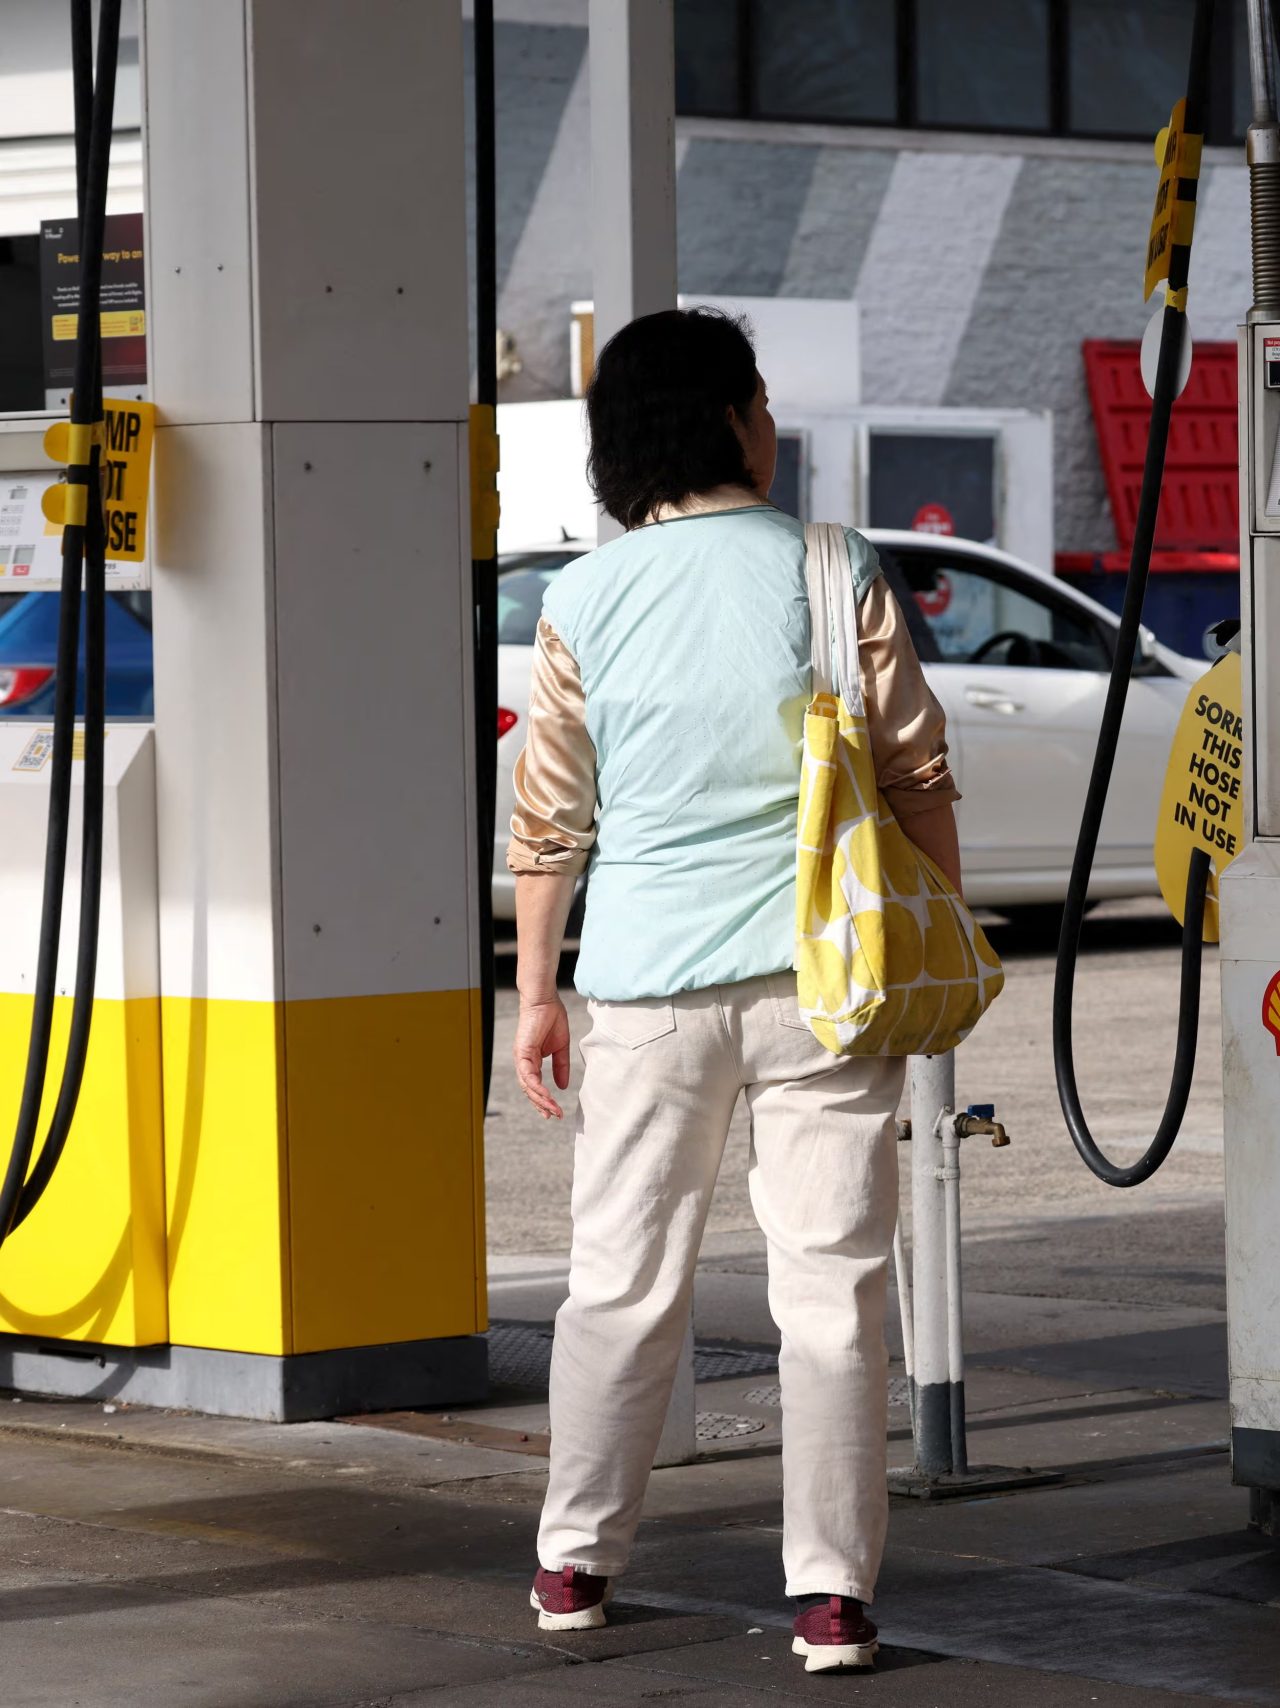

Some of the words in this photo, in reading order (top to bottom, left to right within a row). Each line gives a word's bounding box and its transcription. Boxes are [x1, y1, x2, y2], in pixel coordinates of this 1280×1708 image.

[58, 253, 80, 264] Powe
[103, 250, 121, 263] way
[122, 250, 129, 259] to
[1195, 694, 1243, 742] SORR
[1203, 728, 1242, 770] THIS
[1188, 752, 1241, 800] HOSE
[1188, 782, 1231, 822] NOT
[1174, 802, 1197, 832] IN
[1202, 818, 1237, 856] USE
